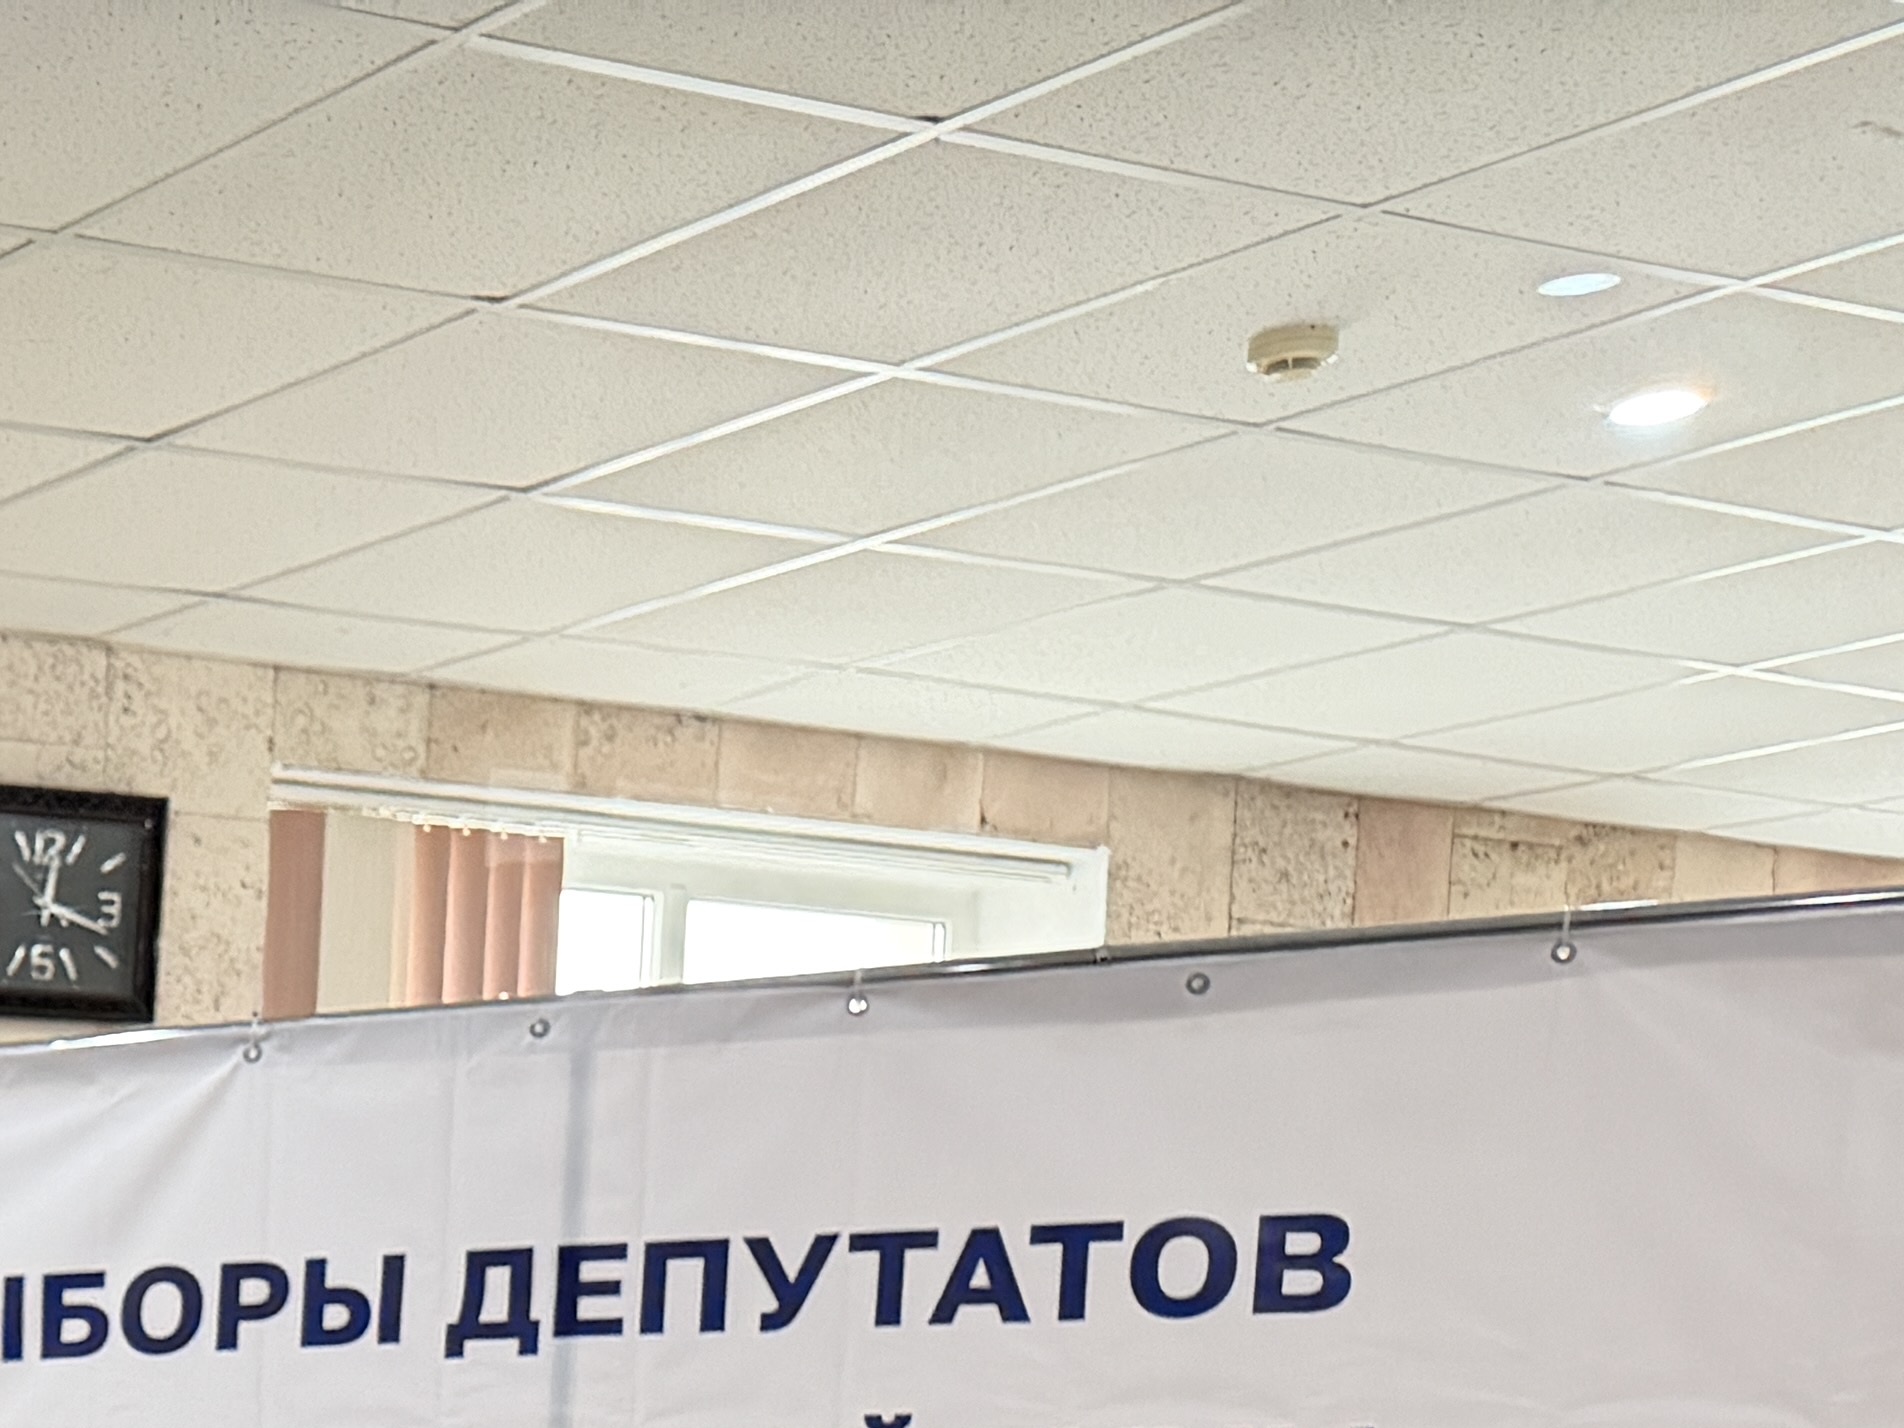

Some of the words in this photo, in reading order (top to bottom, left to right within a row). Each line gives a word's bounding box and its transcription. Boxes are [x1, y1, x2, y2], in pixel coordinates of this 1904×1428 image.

[33, 829, 66, 865] 12
[96, 891, 122, 928] 3
[445, 1214, 1352, 1359] ДЕПУТАТОВ
